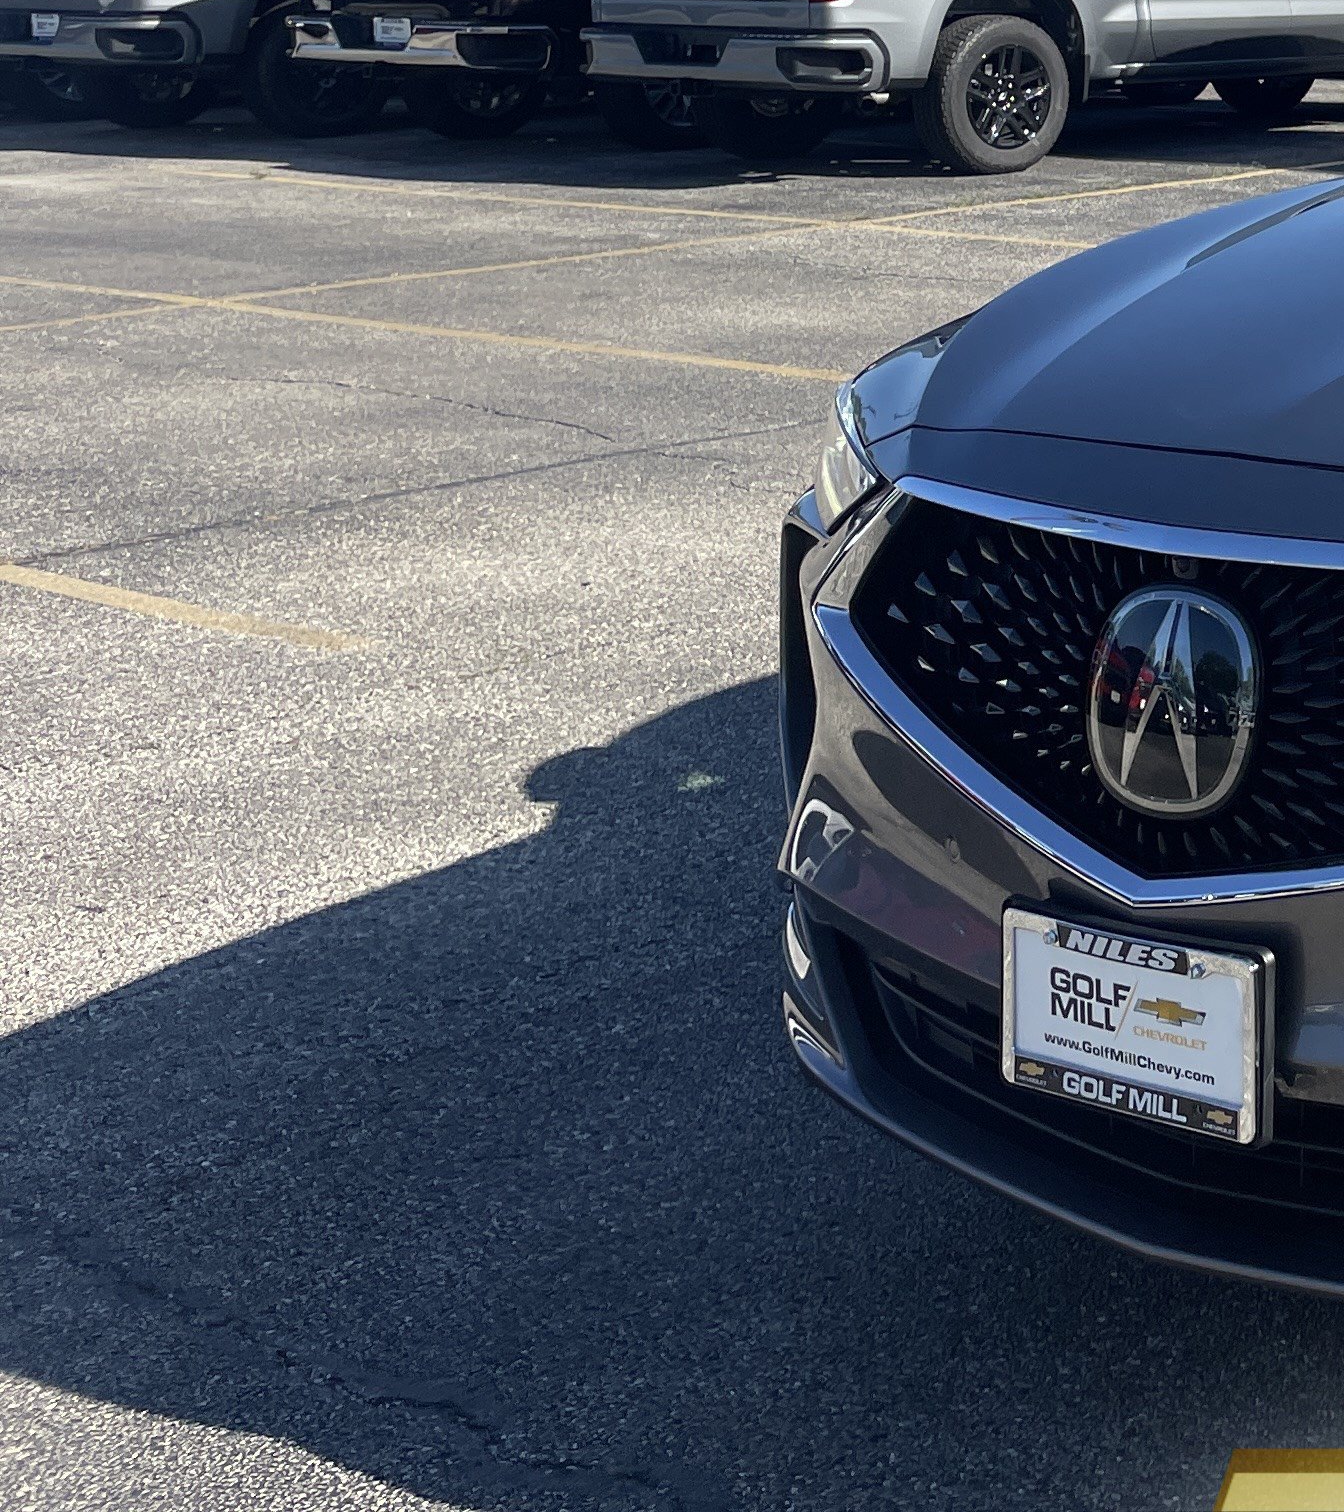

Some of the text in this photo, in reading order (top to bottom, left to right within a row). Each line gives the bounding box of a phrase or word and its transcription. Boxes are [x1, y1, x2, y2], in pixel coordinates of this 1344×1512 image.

[1065, 928, 1179, 971] NILES
[1050, 966, 1131, 1008] GOLF
[1050, 991, 1118, 1033] MILL
[1043, 1032, 1216, 1086] www.GolfMillChevy.com
[1132, 1025, 1208, 1052] CHEVROLET
[1062, 1070, 1188, 1123] GOLF MILL
